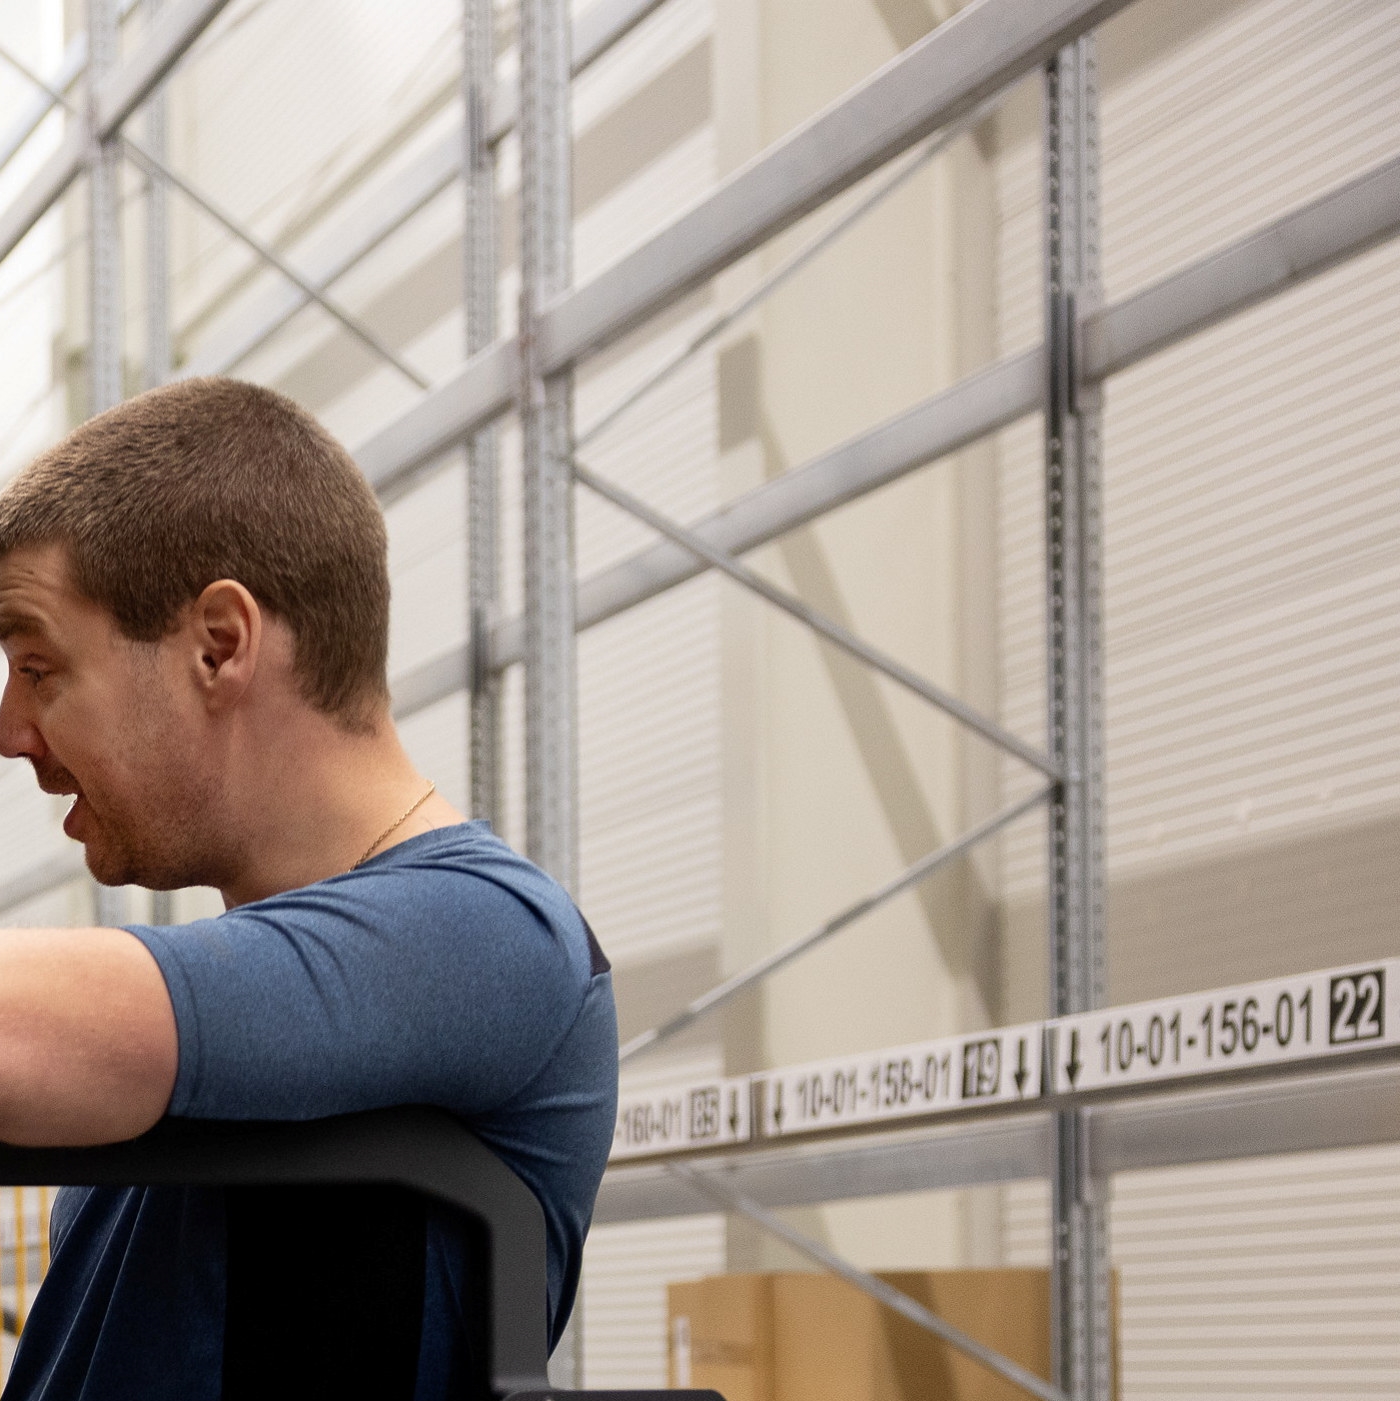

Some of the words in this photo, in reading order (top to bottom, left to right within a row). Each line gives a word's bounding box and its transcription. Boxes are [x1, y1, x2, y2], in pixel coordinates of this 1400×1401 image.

[1101, 986, 1312, 1073] 10-01-156-01
[1332, 973, 1382, 1042] 22
[799, 1049, 952, 1120] 10-01-158-01
[965, 1042, 999, 1096] 19
